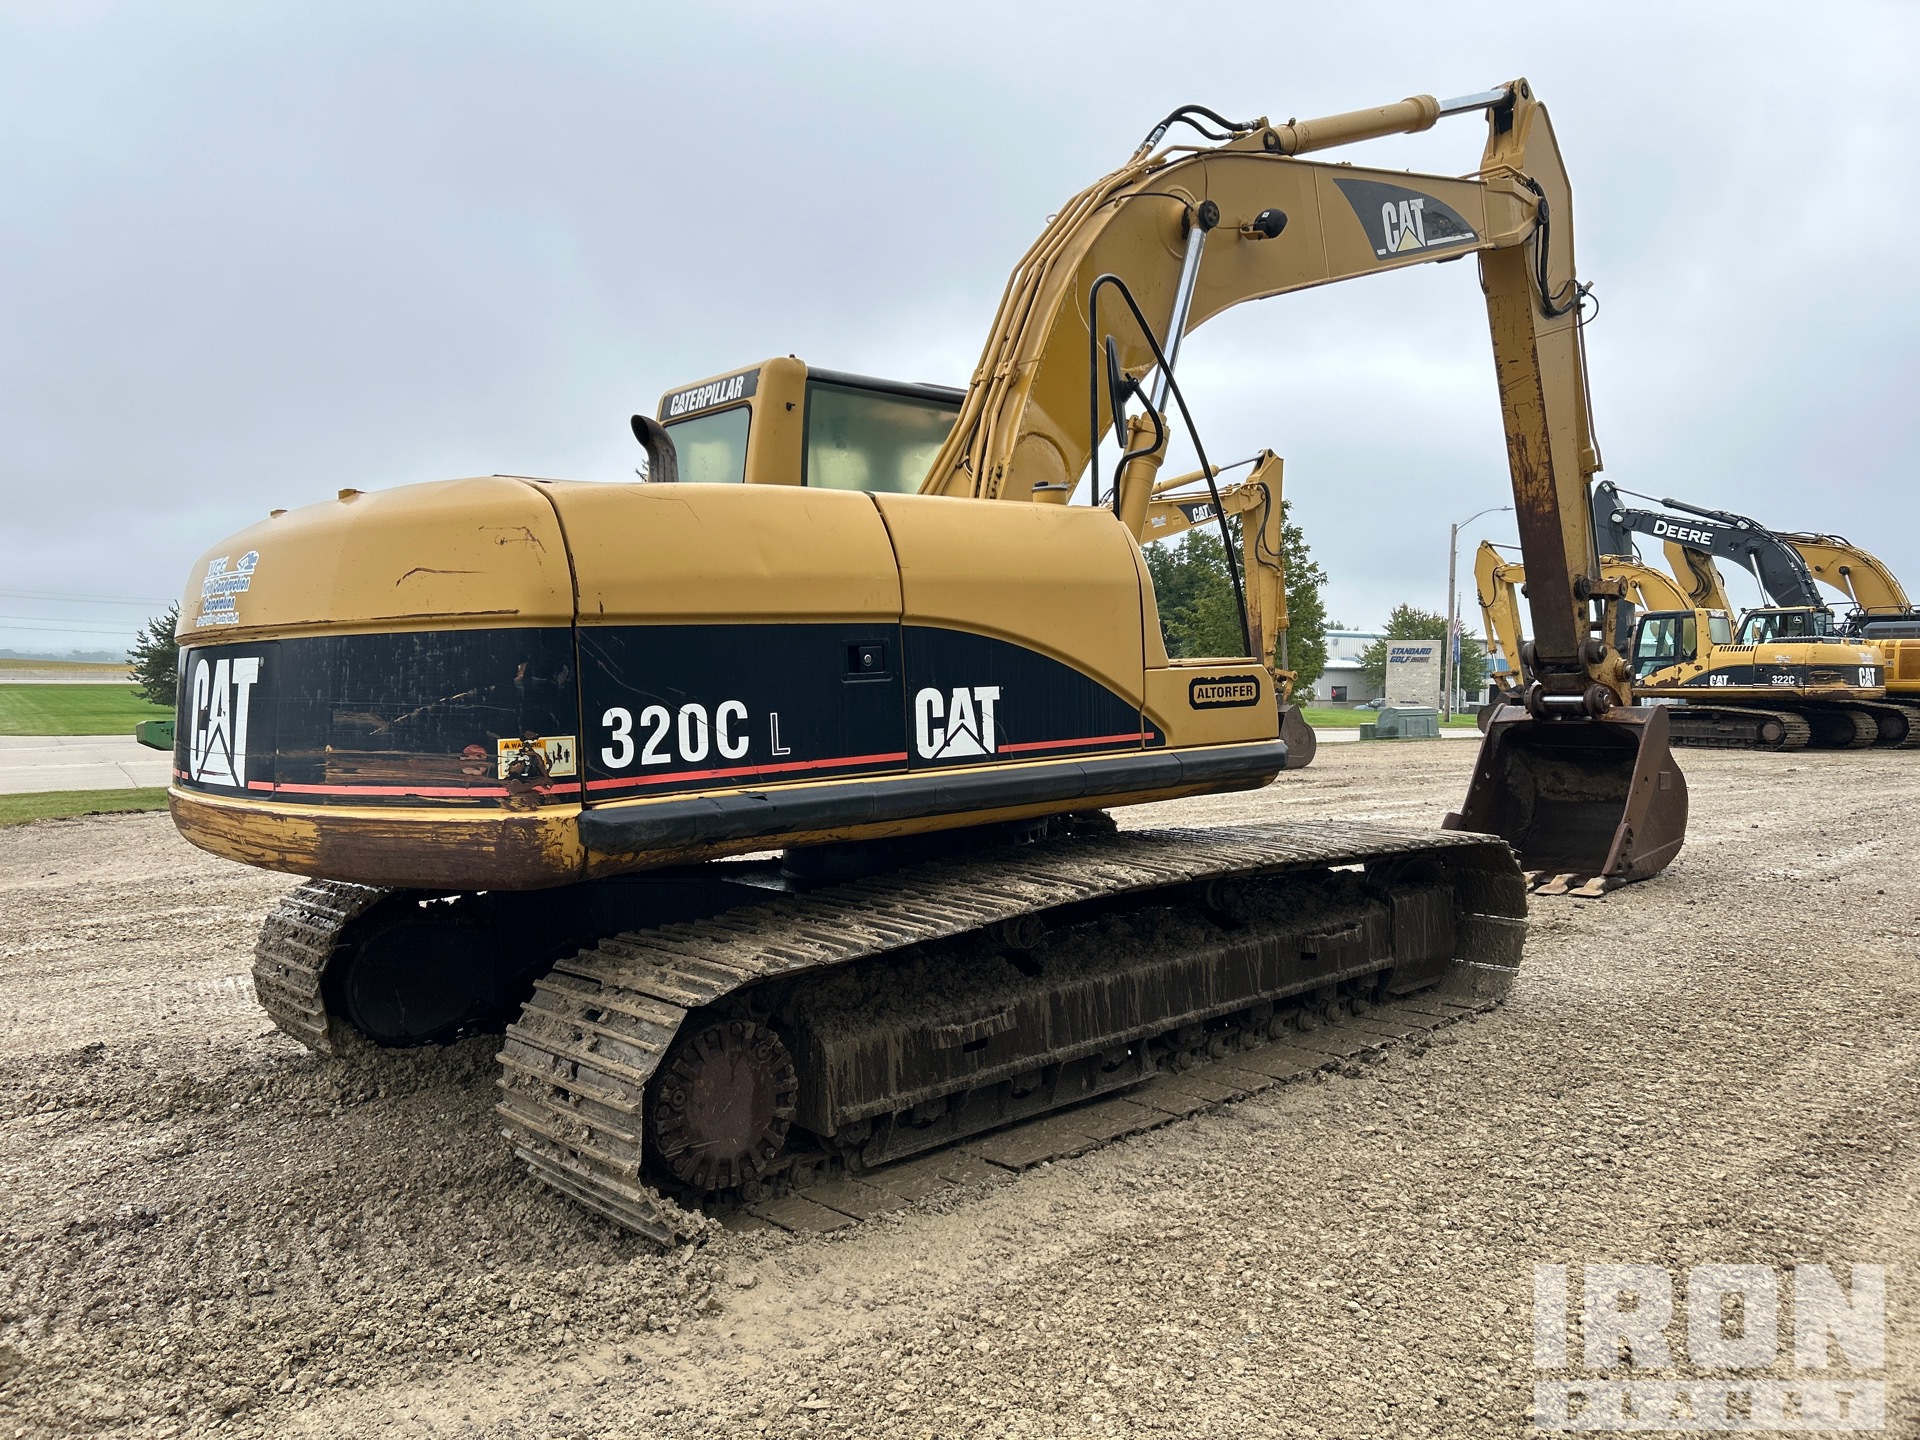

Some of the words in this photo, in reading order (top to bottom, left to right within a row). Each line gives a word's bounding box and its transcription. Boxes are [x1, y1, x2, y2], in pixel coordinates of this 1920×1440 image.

[1381, 198, 1427, 253] CAT
[670, 376, 744, 416] CATERPILLAR
[1192, 504, 1209, 522] CAT
[1653, 520, 1713, 546] DEERE
[203, 597, 236, 612] Corporation
[1709, 675, 1729, 686] CAT
[1771, 675, 1795, 685] 322C
[1858, 667, 1876, 687] CAT
[1197, 685, 1253, 699] ALTORFER
[190, 657, 260, 788] CAT
[915, 685, 1000, 760] CAT
[601, 700, 749, 769] 320C
[770, 712, 790, 757] L
